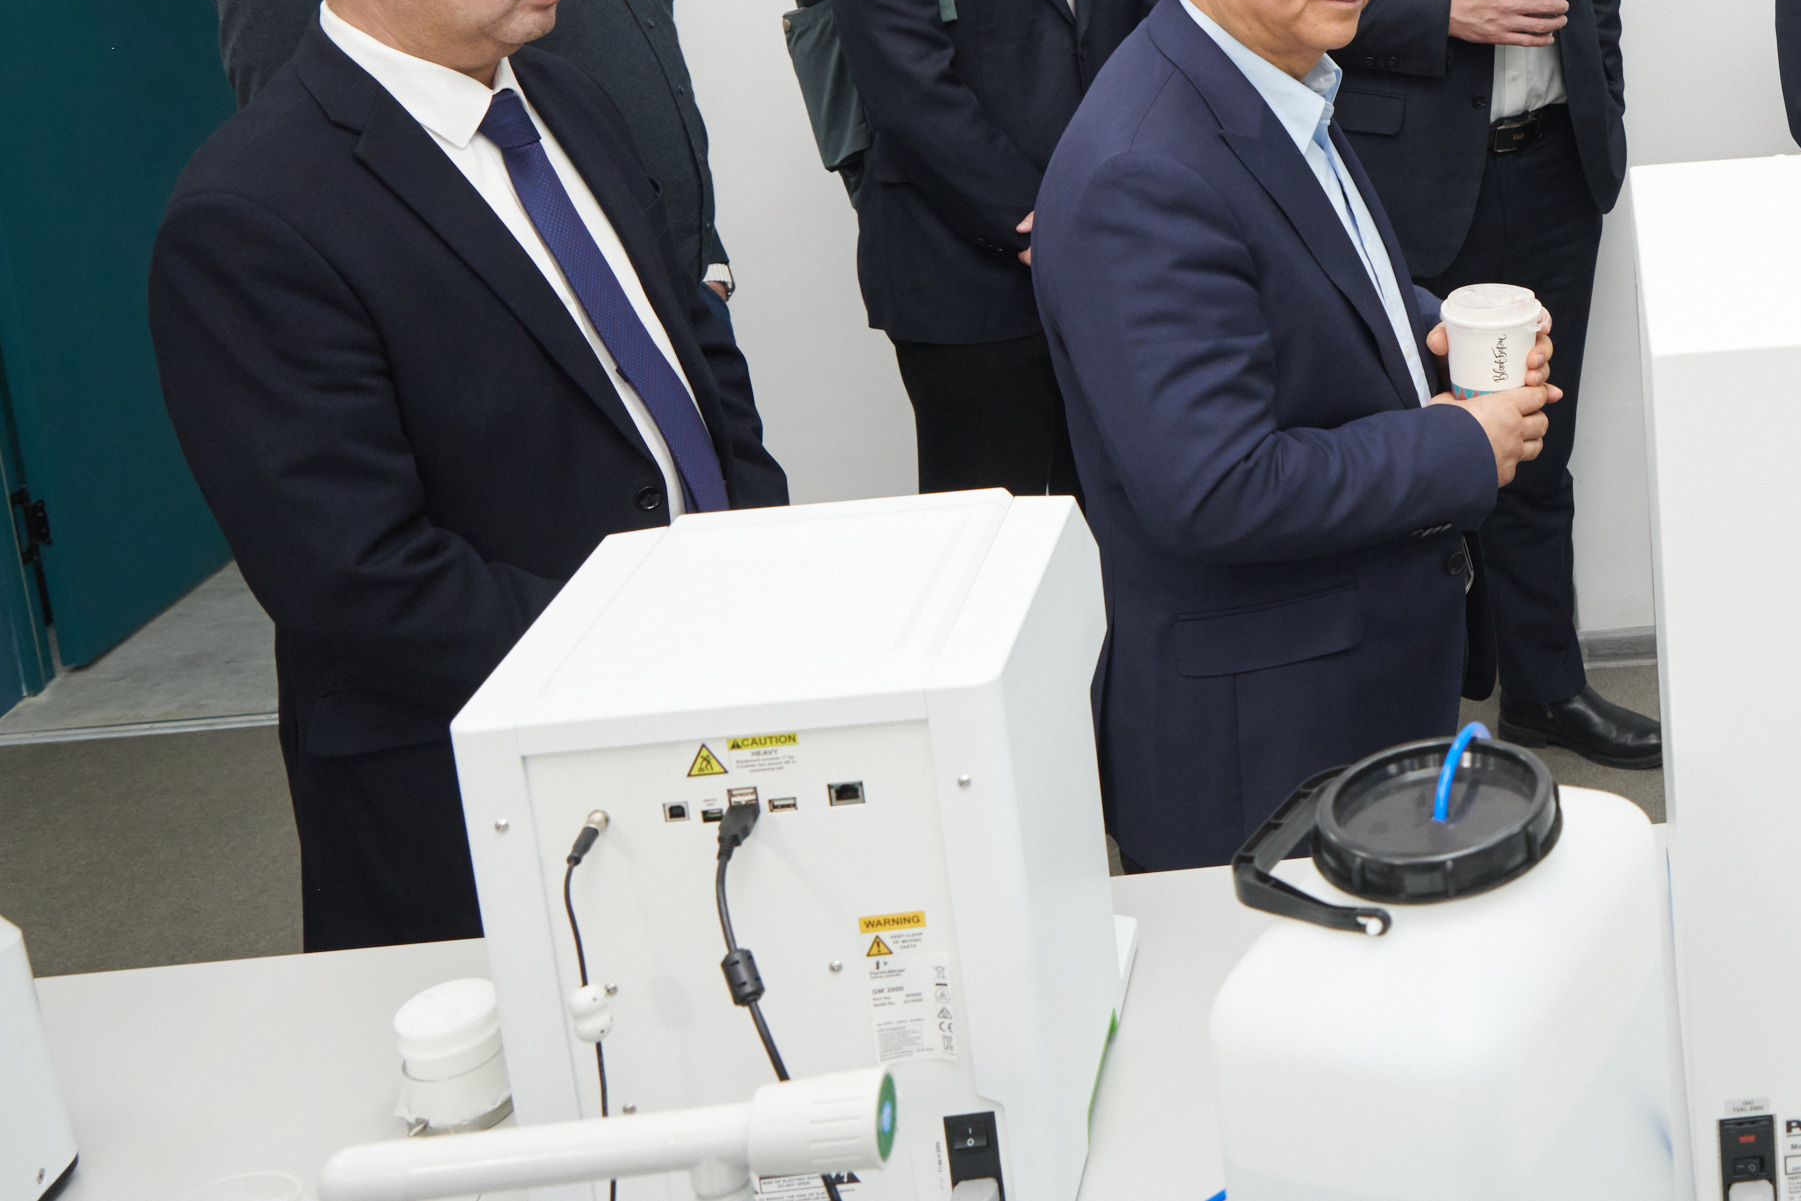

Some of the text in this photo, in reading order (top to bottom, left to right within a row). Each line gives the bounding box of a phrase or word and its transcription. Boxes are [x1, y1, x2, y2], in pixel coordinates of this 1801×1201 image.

[741, 734, 796, 748] CAUTION
[751, 749, 778, 757] HEAVY
[864, 915, 920, 929] WARNING
